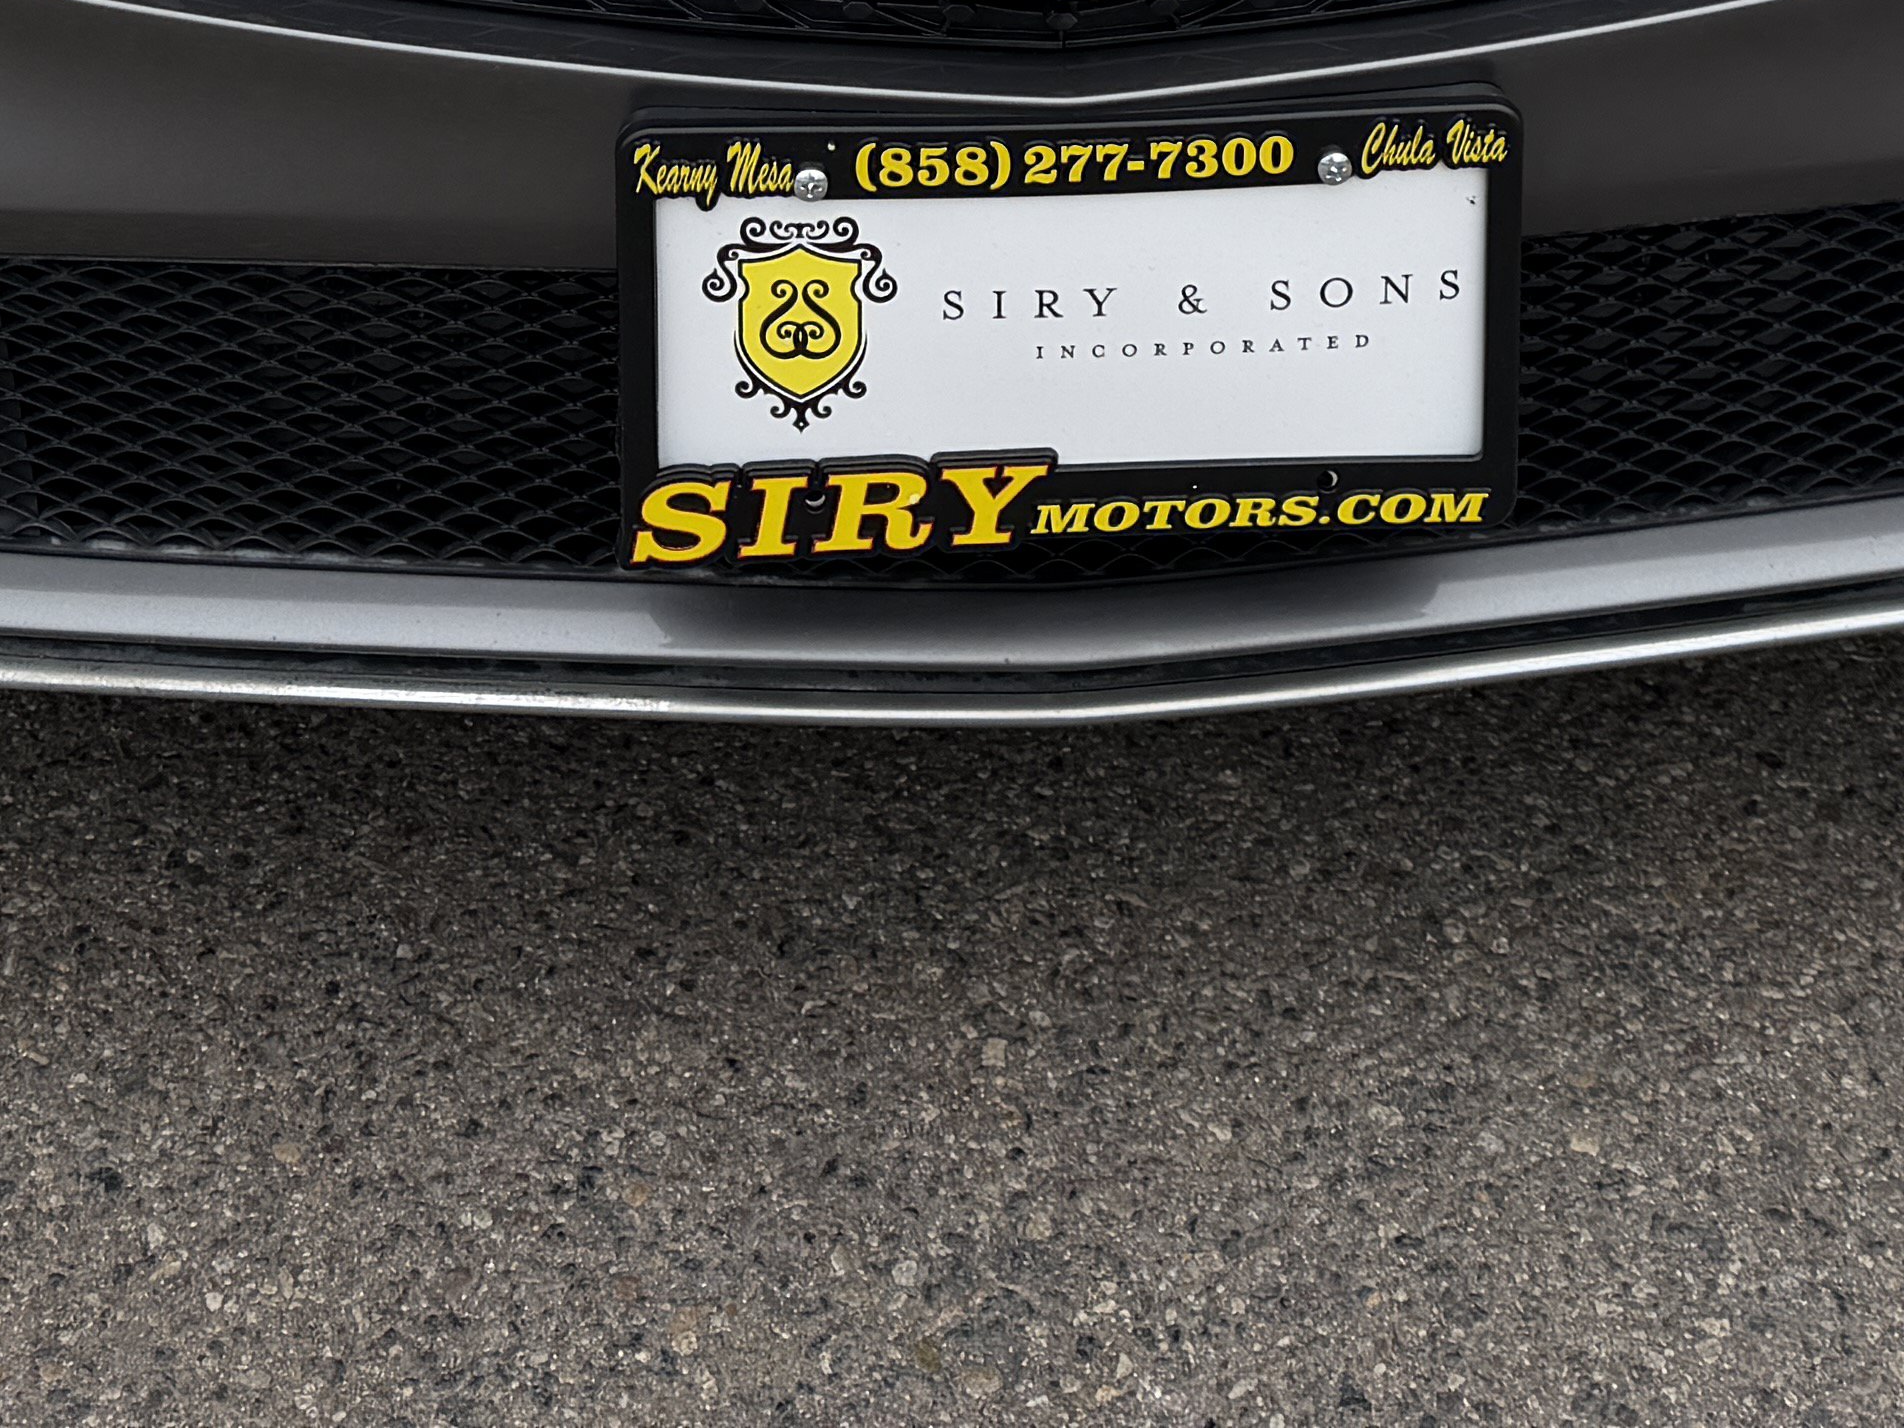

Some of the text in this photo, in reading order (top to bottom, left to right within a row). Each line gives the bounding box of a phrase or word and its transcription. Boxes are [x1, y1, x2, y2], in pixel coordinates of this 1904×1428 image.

[633, 141, 795, 207] Kearny Mesa
[855, 135, 1294, 192] (858) 277-7300
[1360, 119, 1509, 176] Chula Vista
[942, 269, 1461, 320] SIRY & SONS
[1036, 334, 1370, 359] INCORPORATED
[630, 461, 1490, 565] SIRY MOTORS.COM
